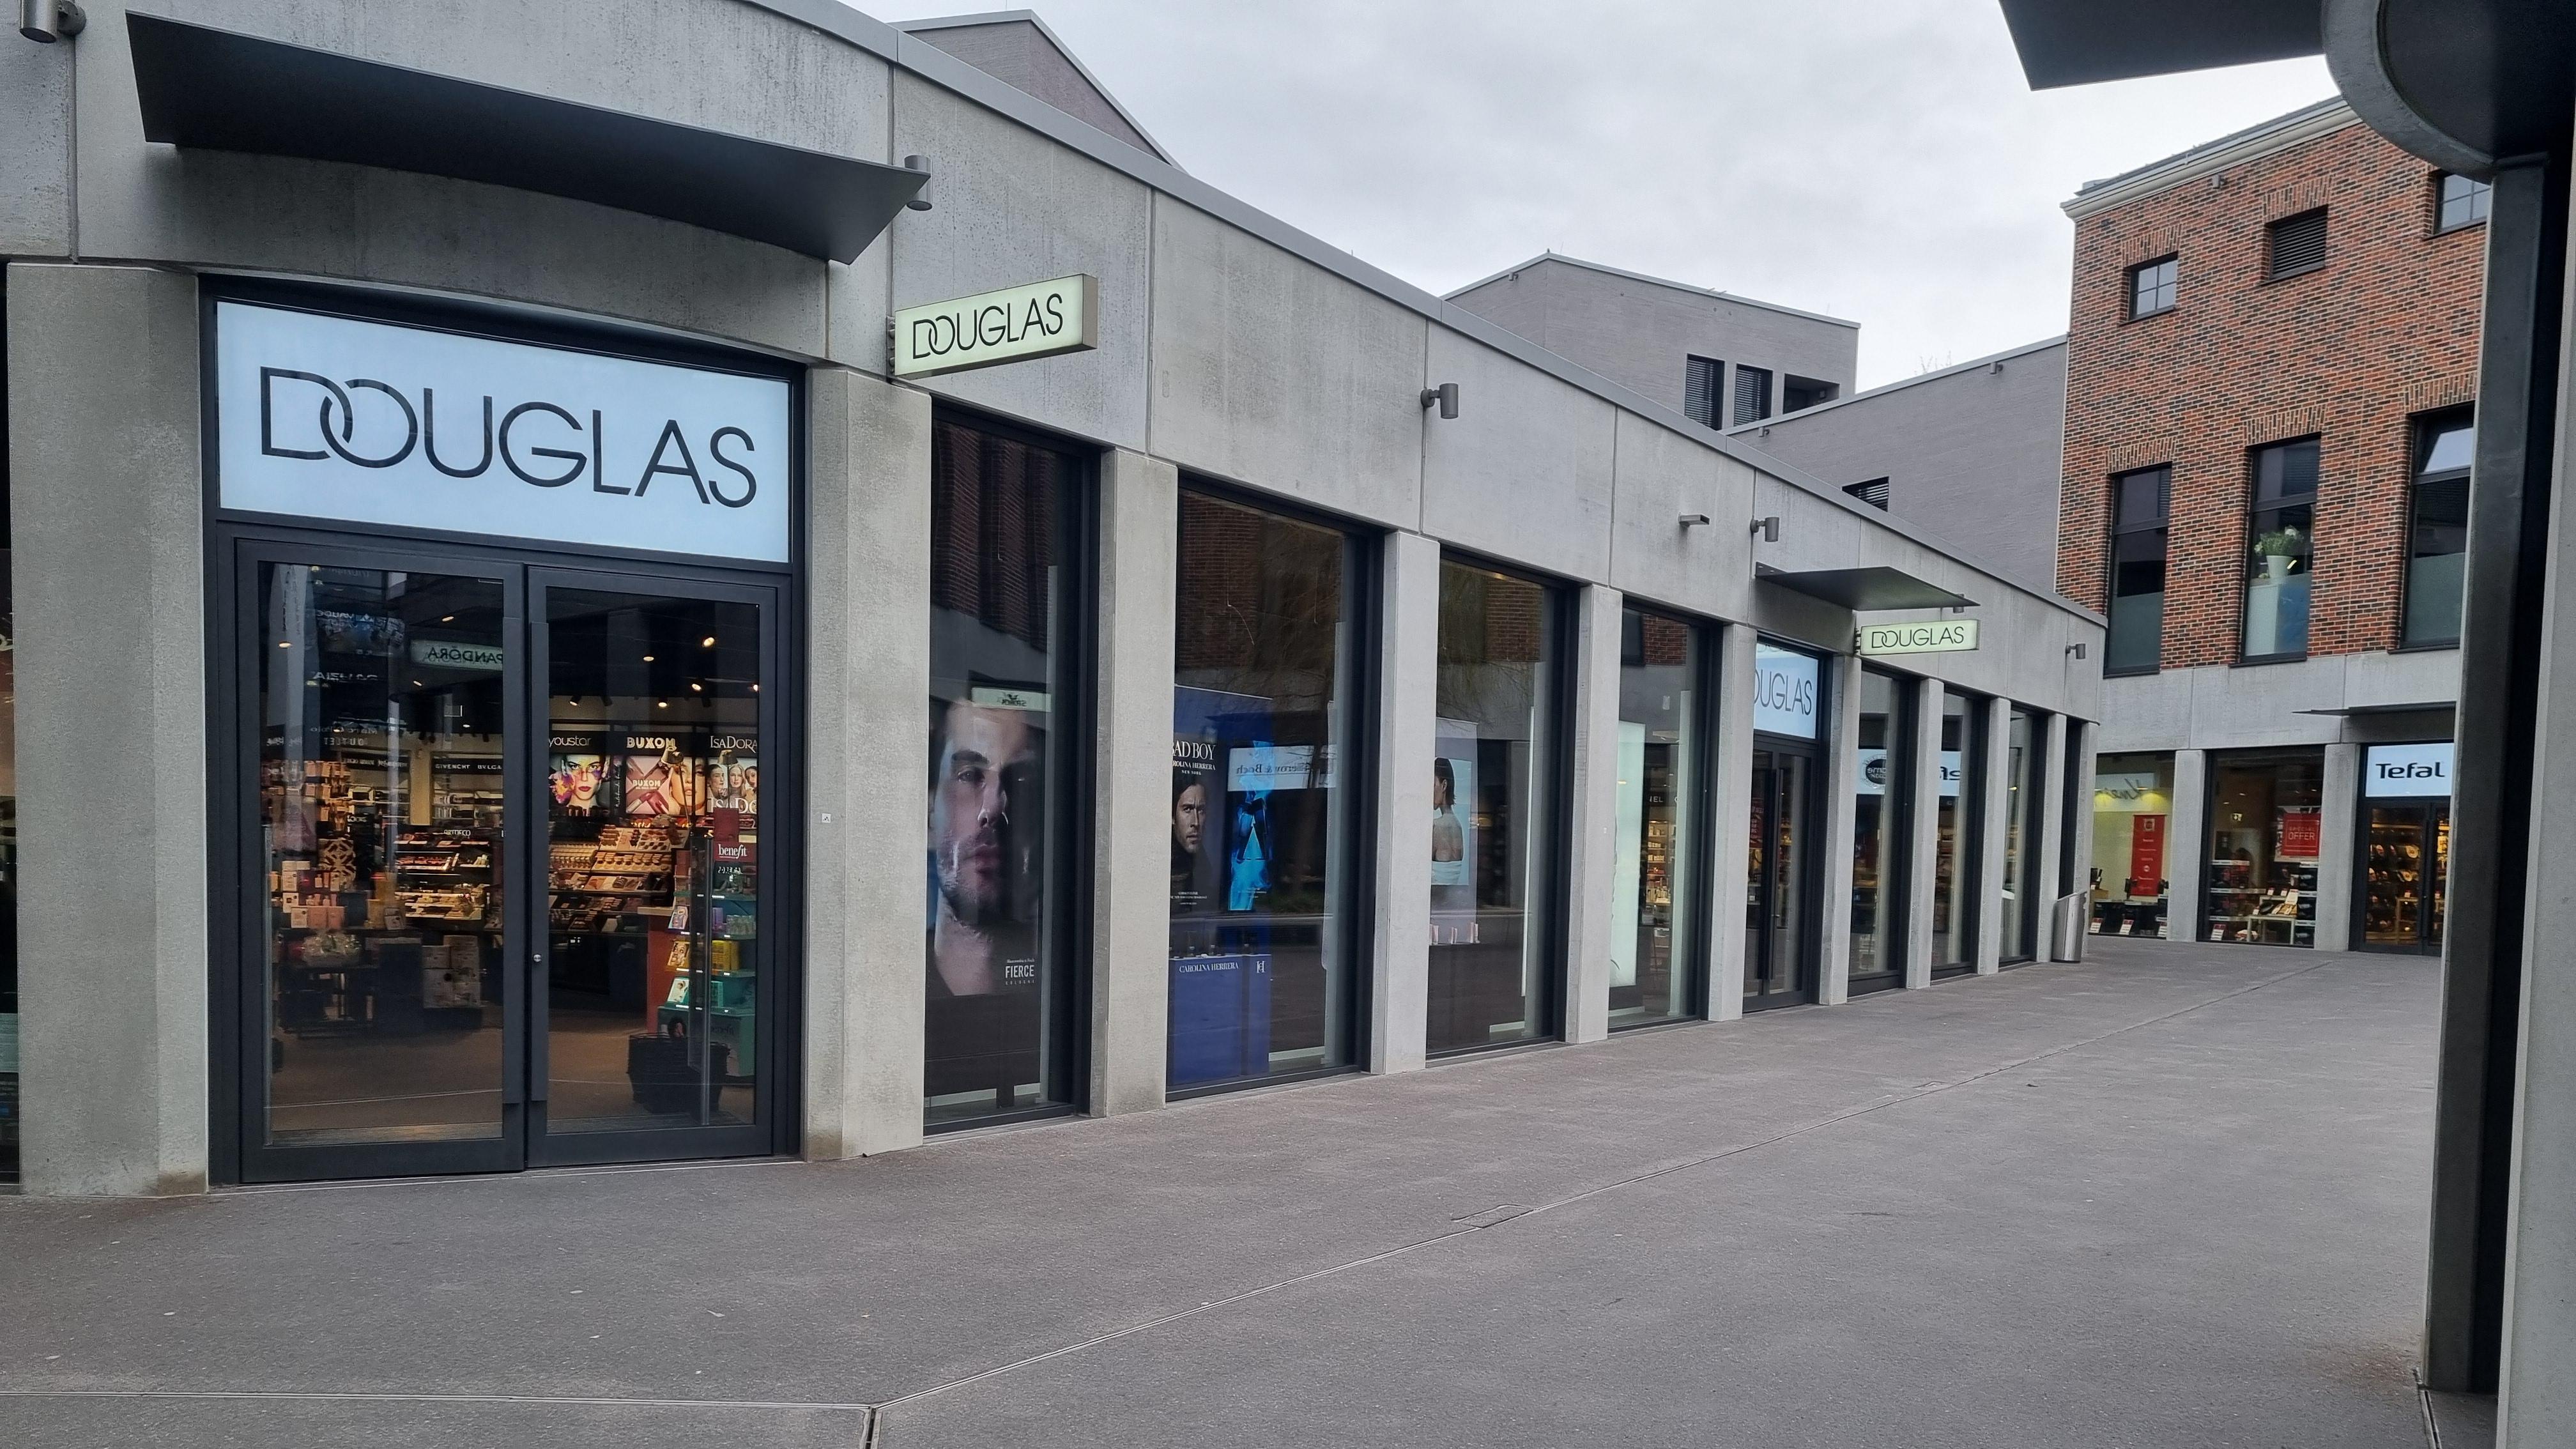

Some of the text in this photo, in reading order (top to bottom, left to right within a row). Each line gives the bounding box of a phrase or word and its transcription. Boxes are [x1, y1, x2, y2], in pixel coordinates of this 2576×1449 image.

[910, 292, 1064, 360] DOUGLAS
[259, 364, 758, 509] DOUGLAS
[1871, 625, 1965, 649] DOUGLAS
[627, 737, 676, 749] BUXOM
[1192, 742, 1215, 760] BOY
[2375, 761, 2446, 779] Tefal
[2288, 832, 2315, 840] OFFER
[717, 843, 747, 859] benefit
[1005, 965, 1034, 979] FIERCE
[1211, 962, 1239, 970] HERRERA
